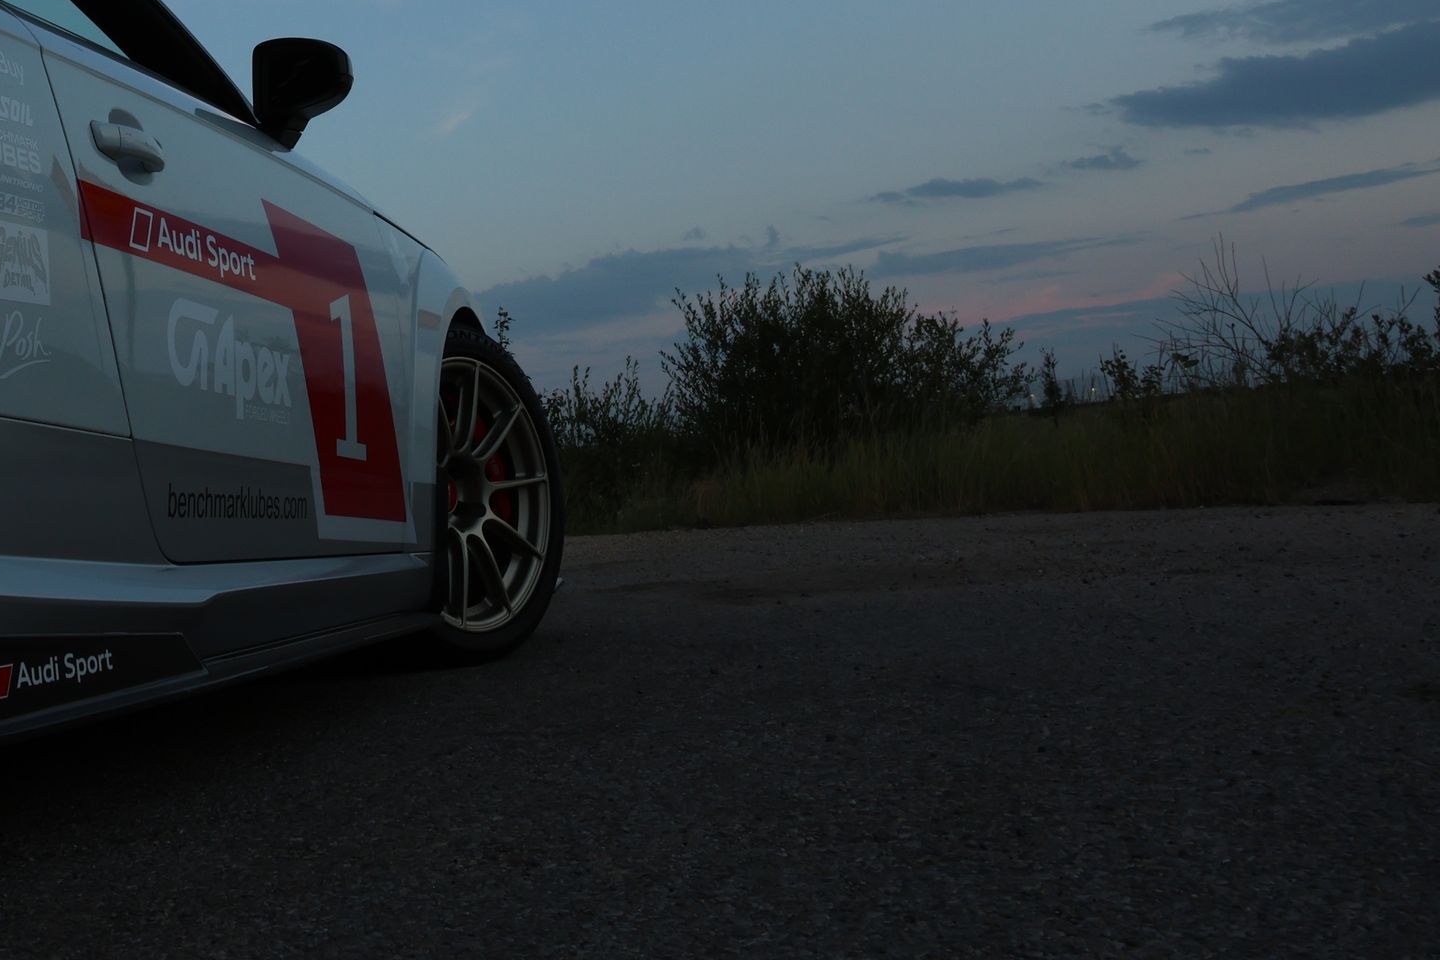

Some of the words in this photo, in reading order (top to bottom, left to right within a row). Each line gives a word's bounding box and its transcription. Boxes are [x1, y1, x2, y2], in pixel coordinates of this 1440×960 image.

[157, 217, 202, 263] Audi
[207, 234, 257, 281] Sport
[329, 293, 368, 462] 1
[167, 481, 308, 520] benchmarklubes.com
[16, 655, 60, 690] Audi
[64, 648, 114, 683] Sport
